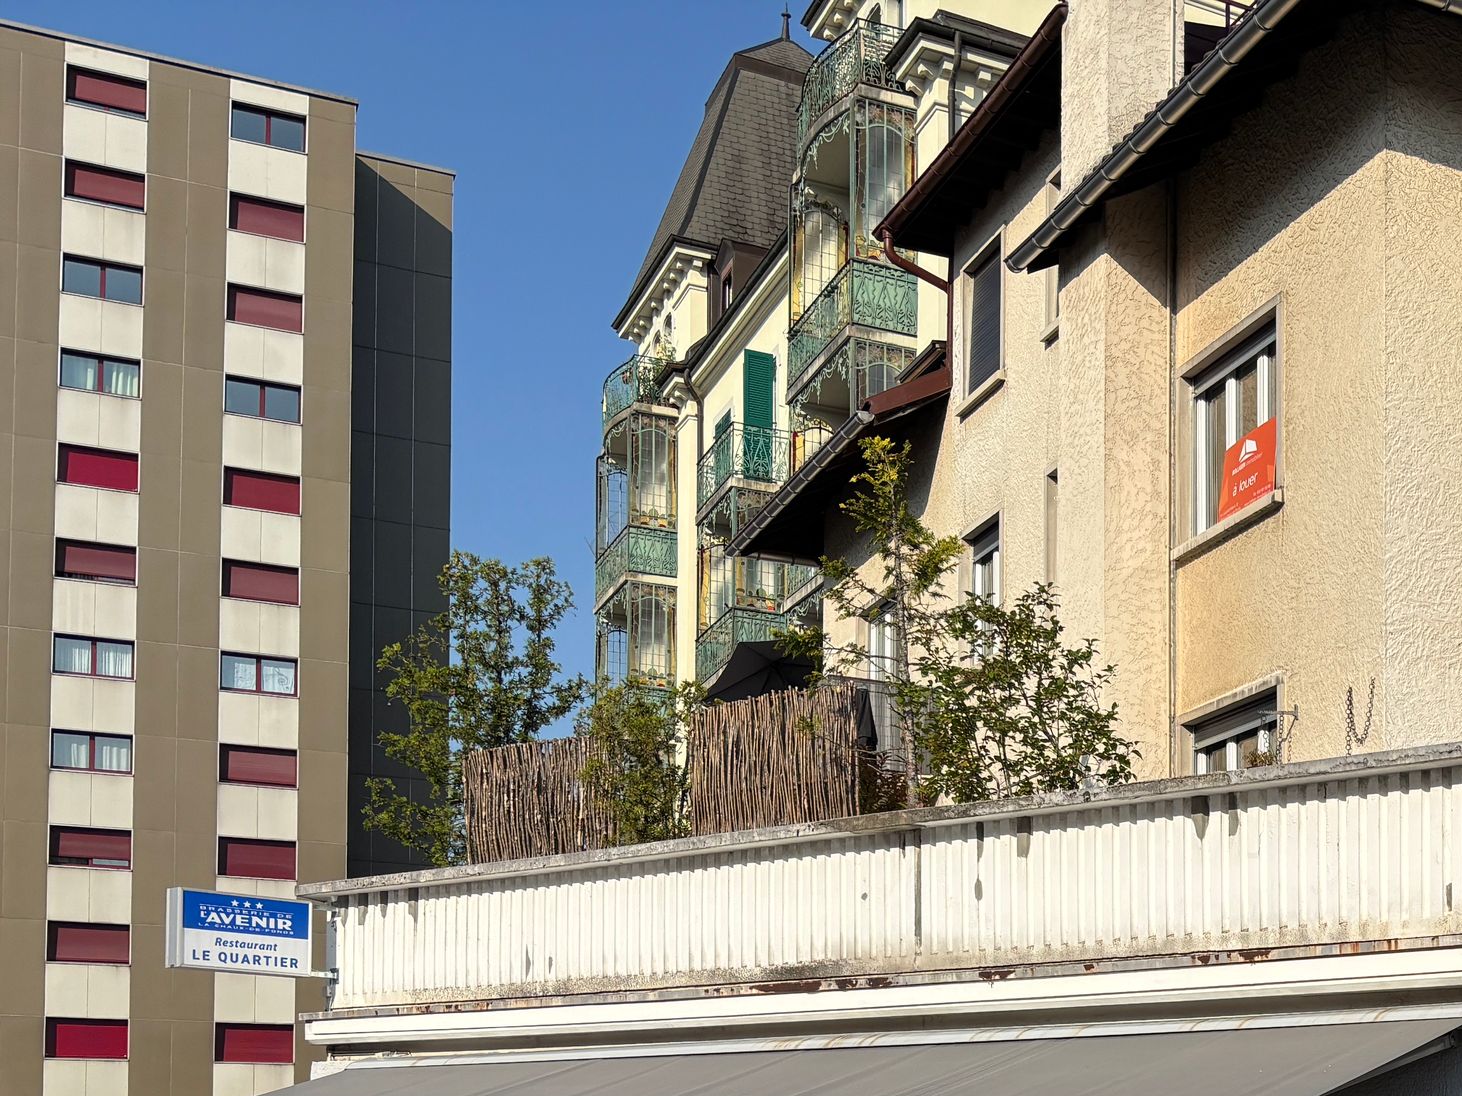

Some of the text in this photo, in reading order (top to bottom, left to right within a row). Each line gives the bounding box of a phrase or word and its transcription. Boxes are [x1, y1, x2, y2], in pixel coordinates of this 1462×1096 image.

[1239, 472, 1258, 492] louer
[199, 905, 270, 916] BRASSERIE
[200, 911, 292, 930] L'AVENIR
[214, 924, 294, 935] CHAUX-DE-FONDS
[214, 937, 278, 952] Restaurant
[192, 949, 299, 969] LE QUARTIER
